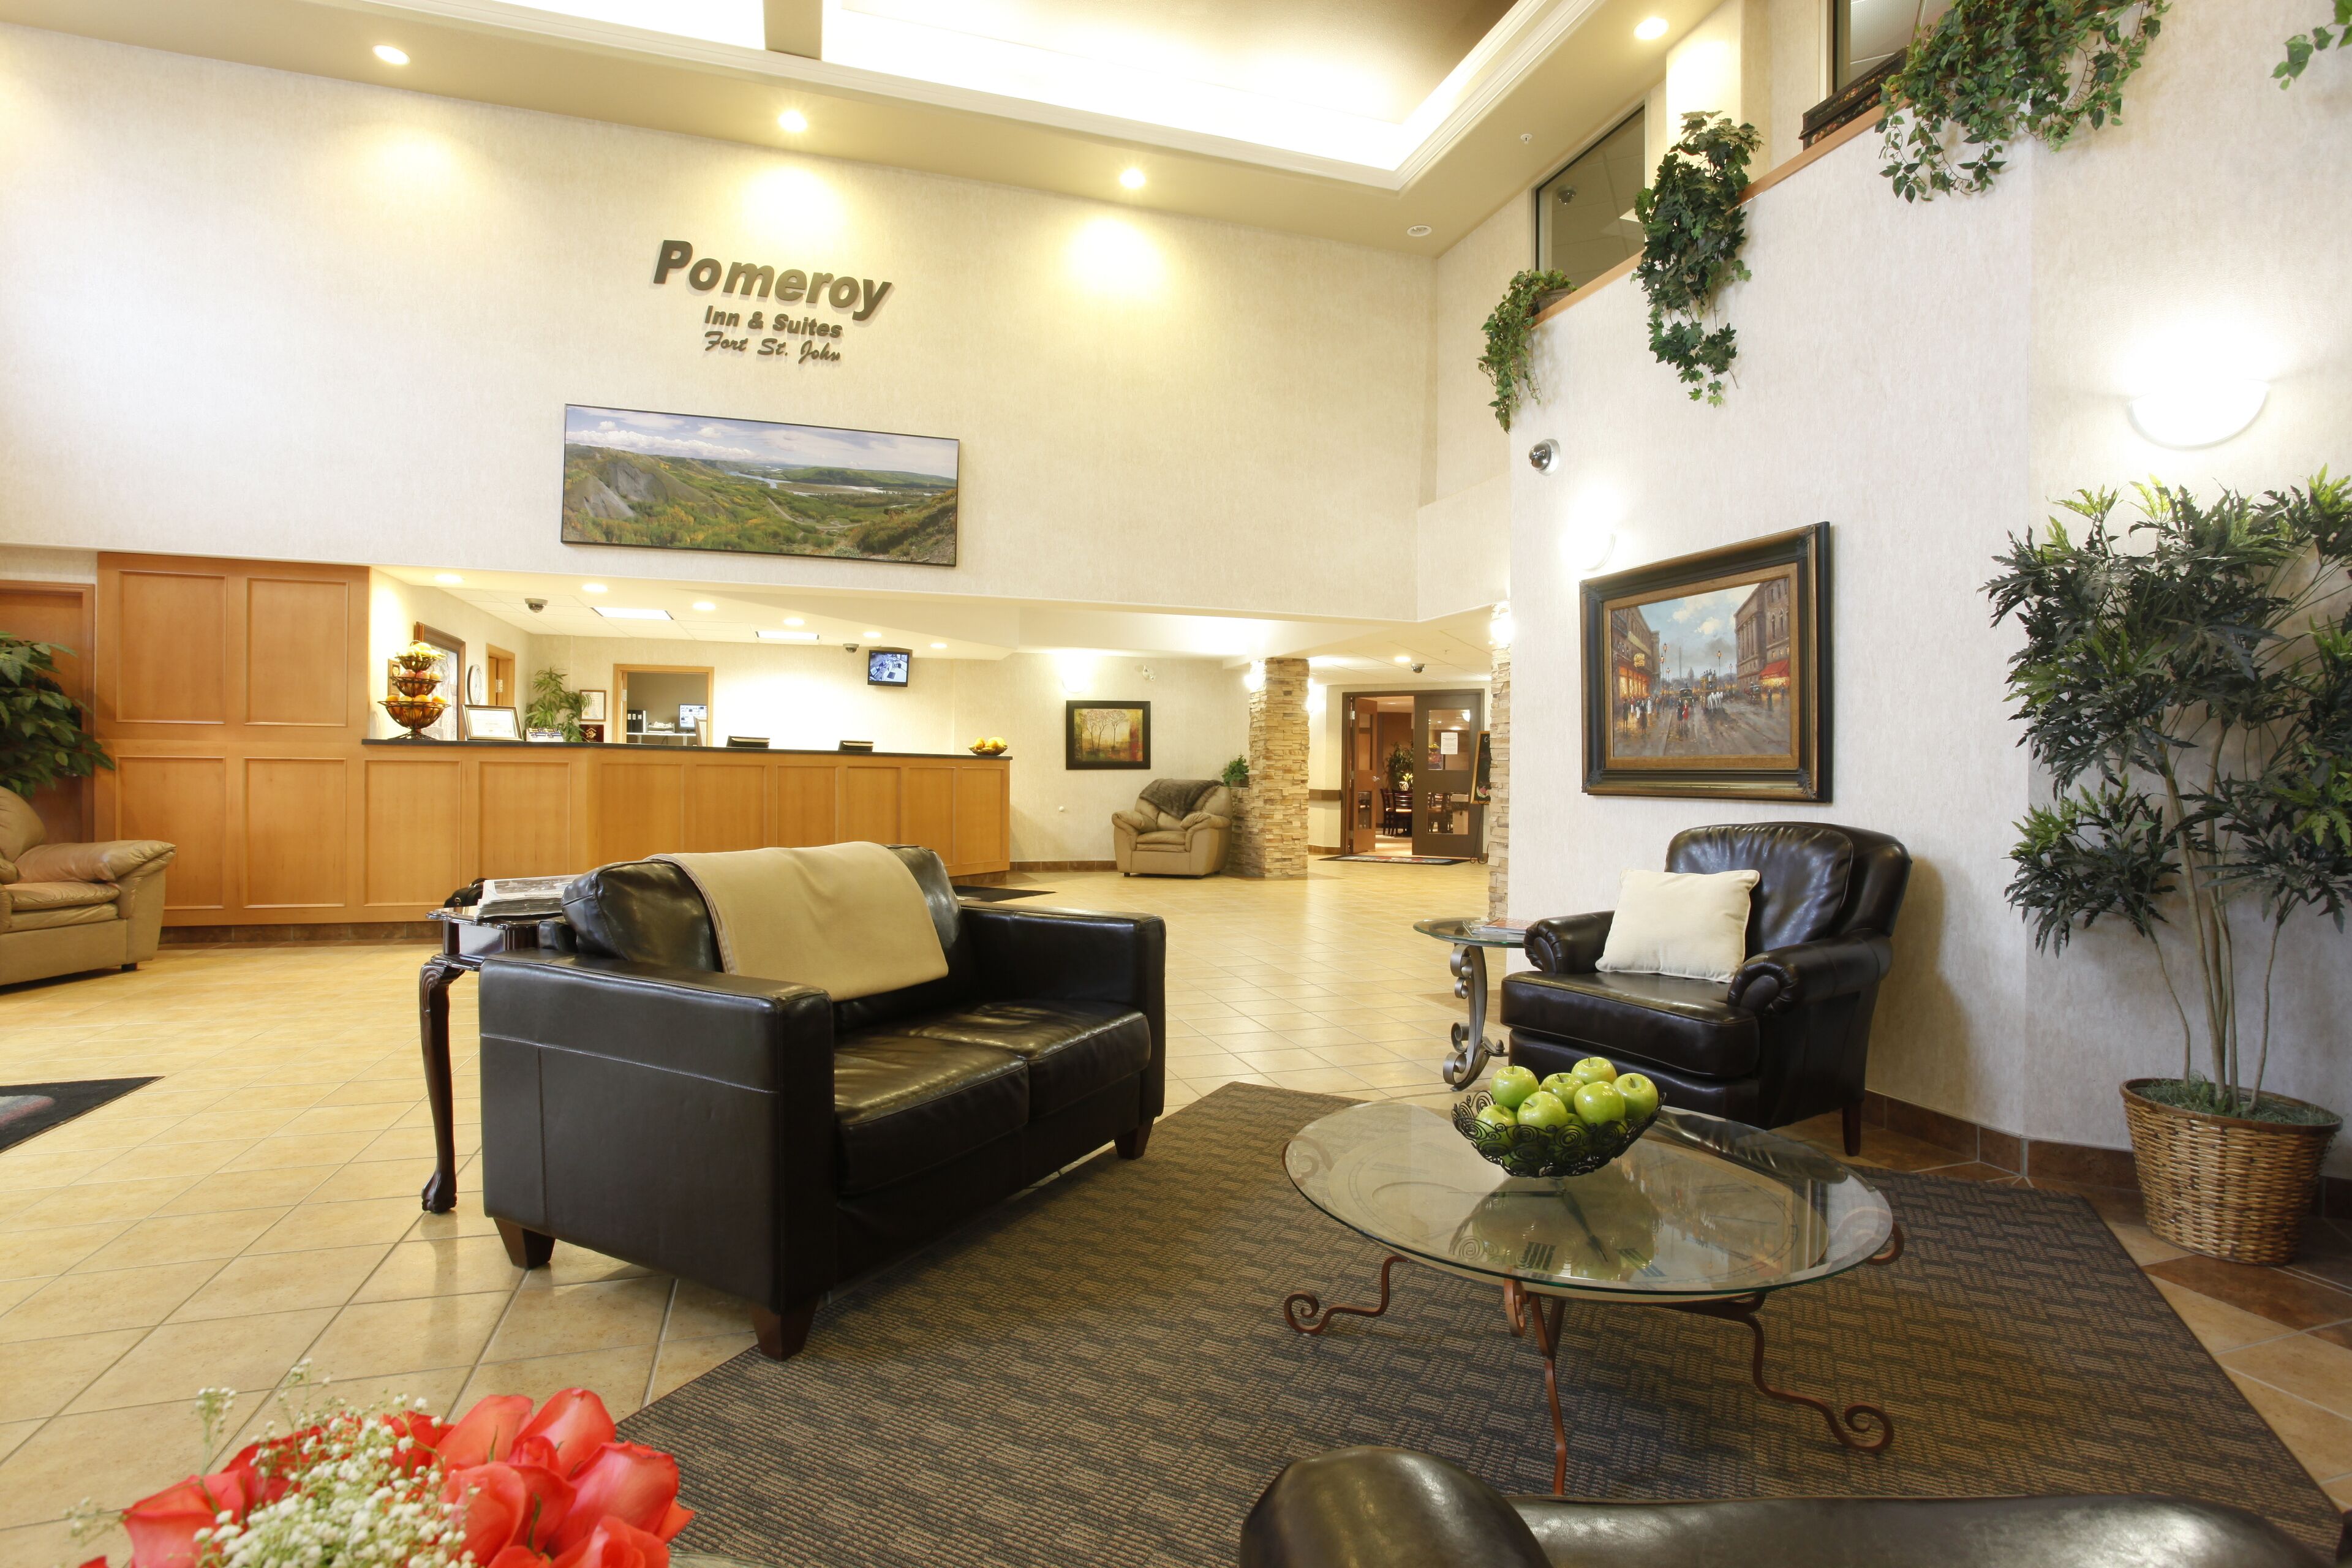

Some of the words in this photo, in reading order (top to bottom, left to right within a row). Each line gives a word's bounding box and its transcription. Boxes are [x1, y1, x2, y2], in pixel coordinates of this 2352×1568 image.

[654, 239, 892, 321] Pomeroy
[704, 305, 740, 326] Inn
[747, 311, 764, 329] &
[772, 313, 842, 338] Suites
[704, 331, 748, 352] Fort
[757, 337, 788, 356] St.
[798, 340, 841, 364] John
